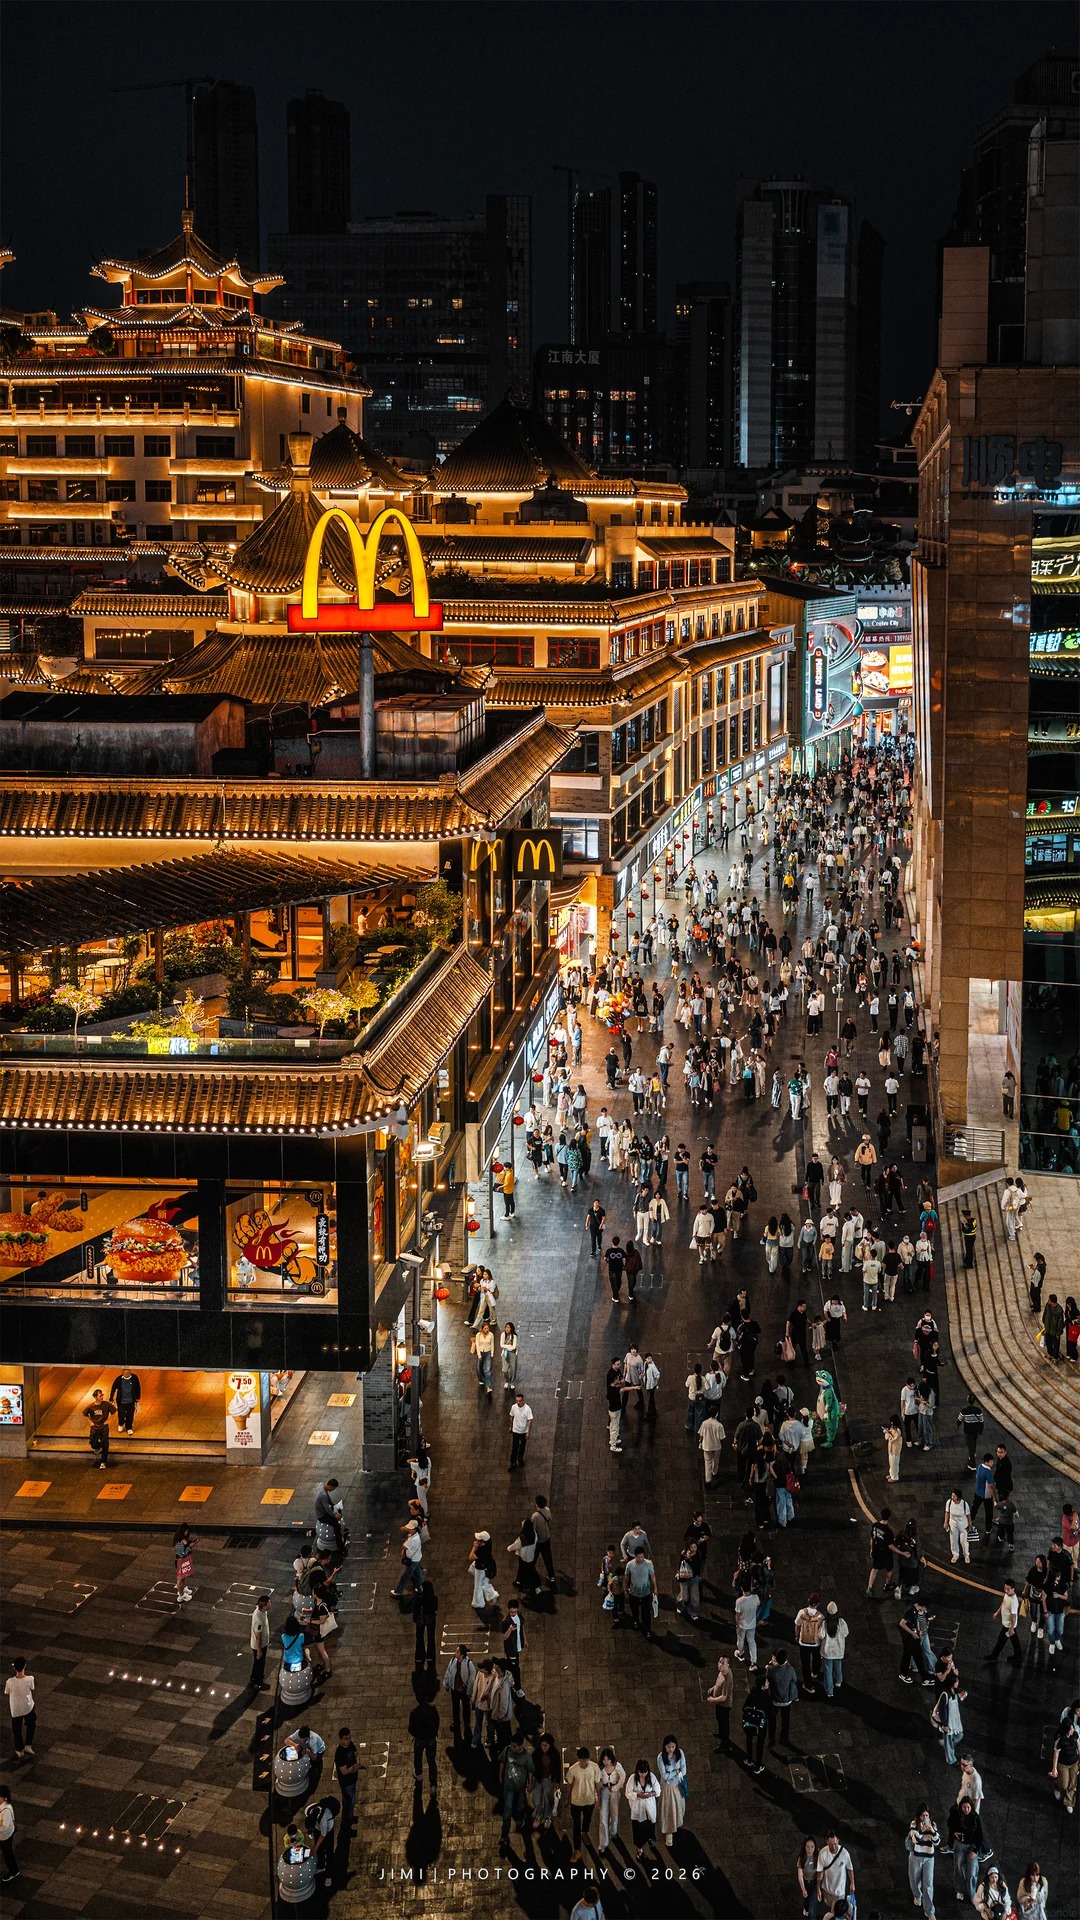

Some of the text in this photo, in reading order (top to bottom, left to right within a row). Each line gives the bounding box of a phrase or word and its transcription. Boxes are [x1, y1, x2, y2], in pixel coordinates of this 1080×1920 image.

[547, 349, 601, 365] 江南大厦
[961, 435, 1063, 490] 顺电
[962, 491, 1059, 502] sundan.com
